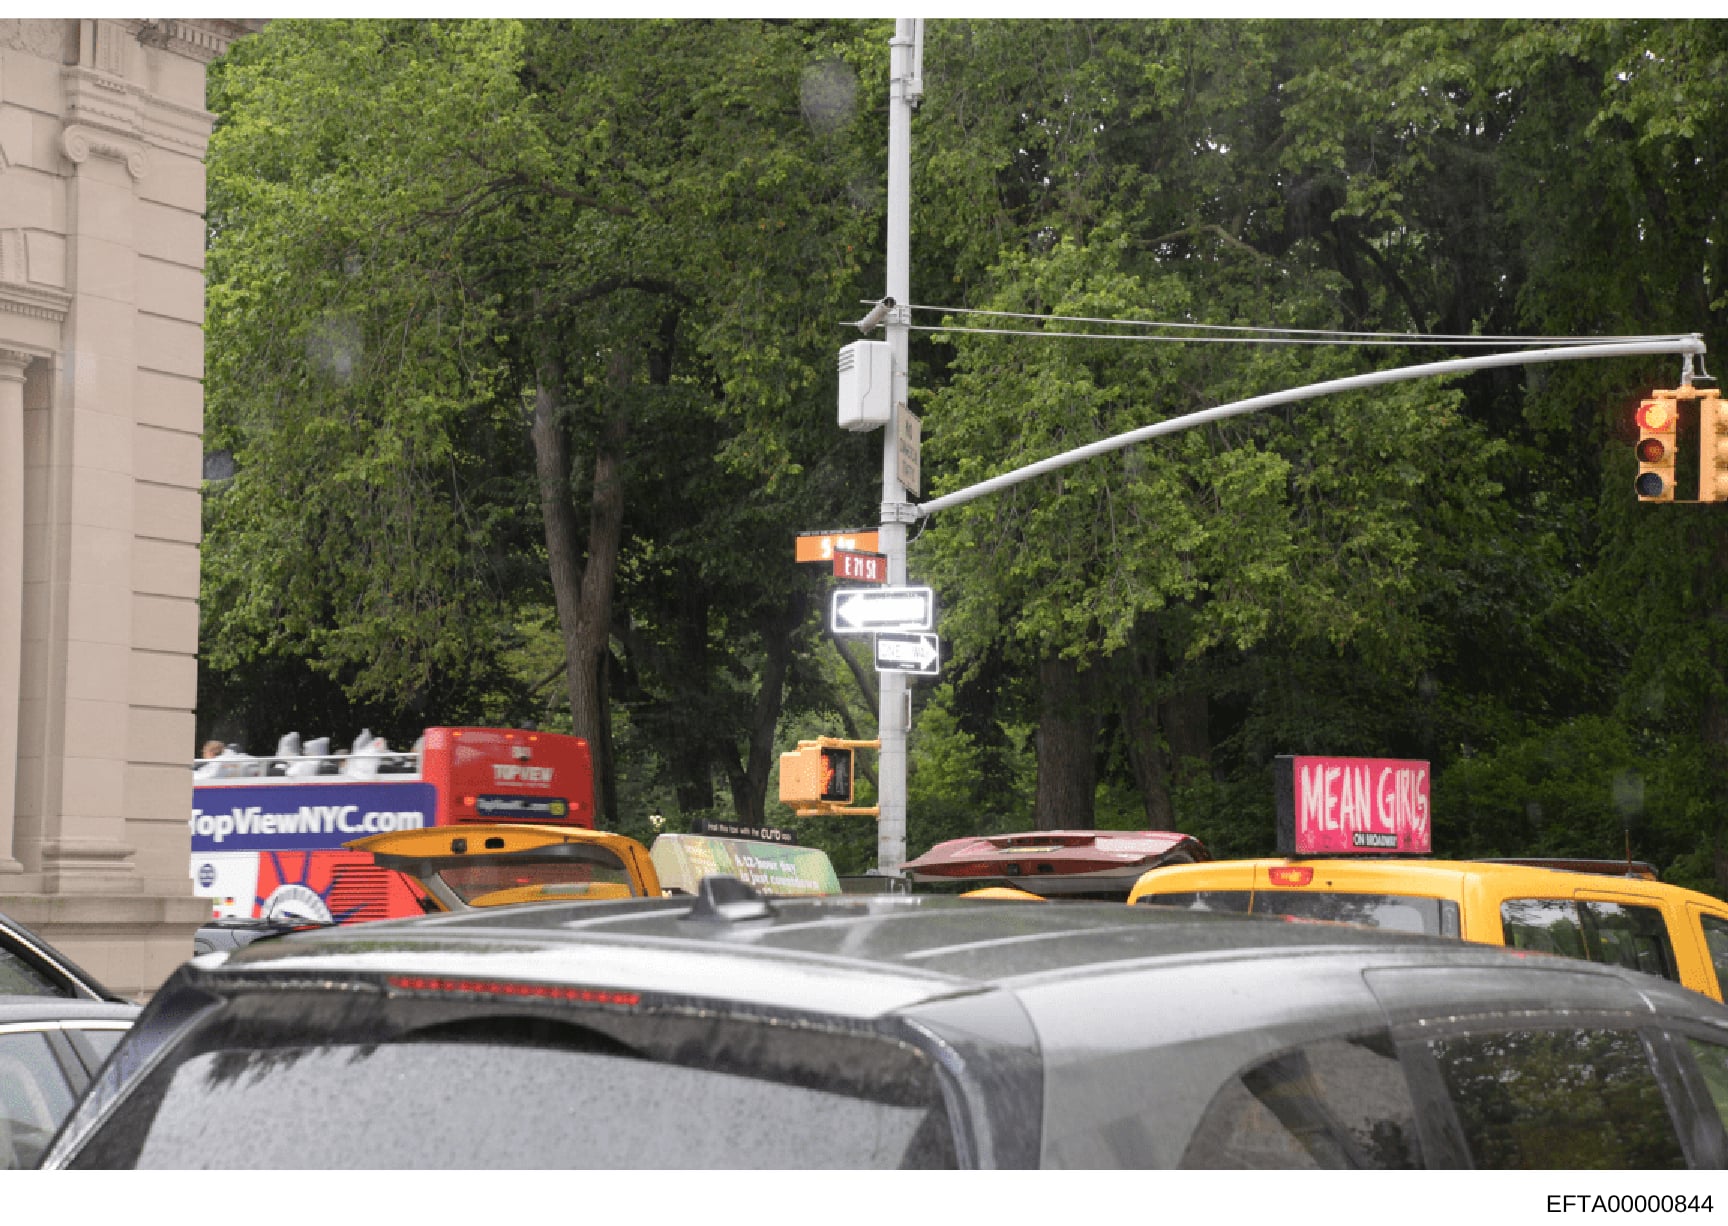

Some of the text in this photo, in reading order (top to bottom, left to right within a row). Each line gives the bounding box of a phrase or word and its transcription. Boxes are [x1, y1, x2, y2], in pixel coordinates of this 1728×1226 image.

[844, 556, 852, 576] E
[1301, 764, 1428, 835] MEAN GIRLS
[190, 805, 424, 843] TopViewNYC.com
